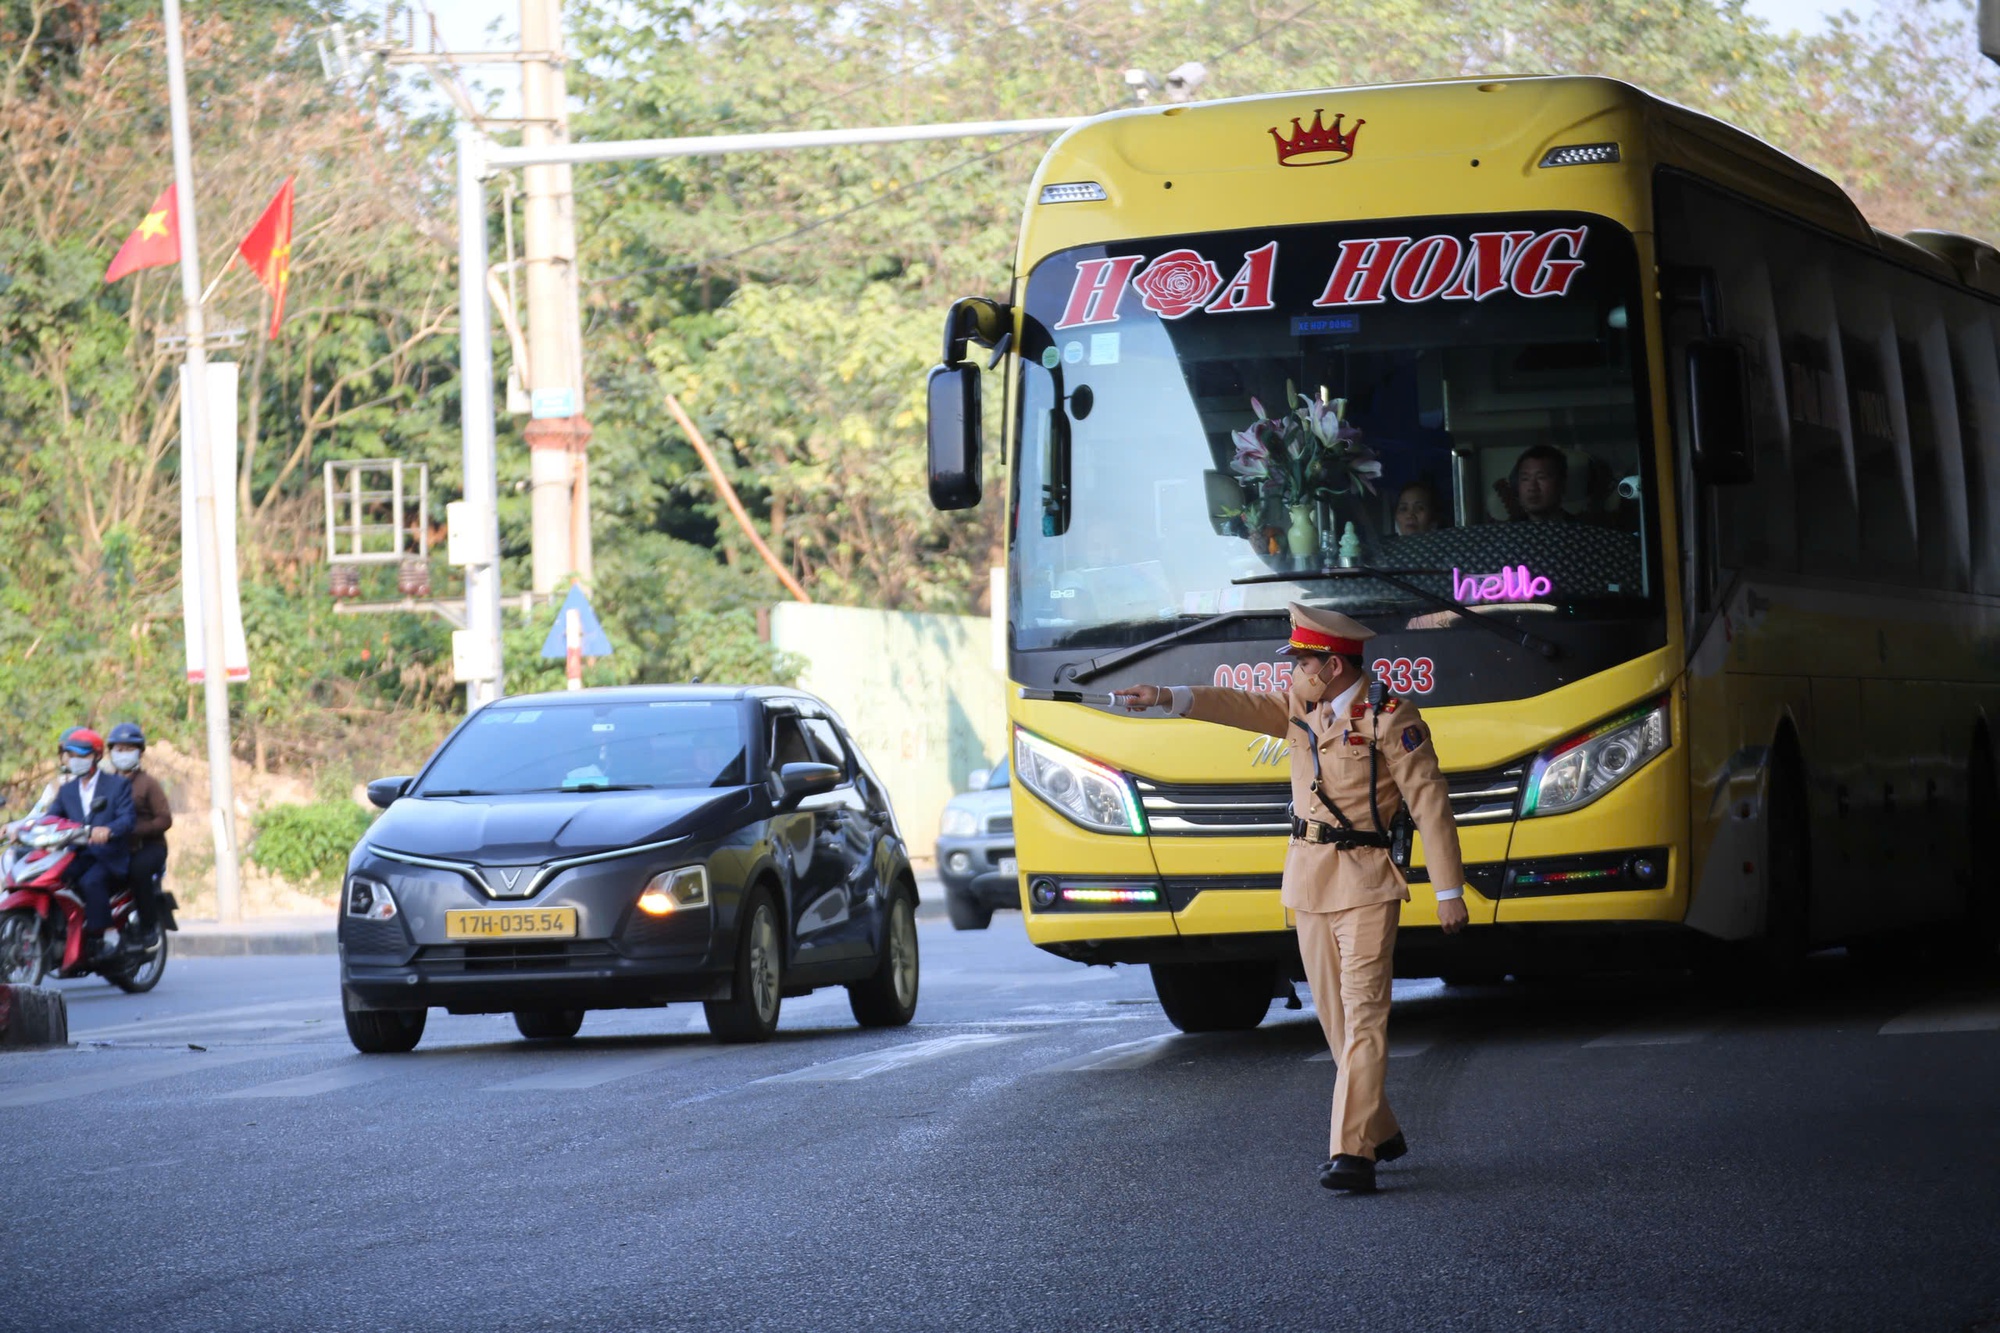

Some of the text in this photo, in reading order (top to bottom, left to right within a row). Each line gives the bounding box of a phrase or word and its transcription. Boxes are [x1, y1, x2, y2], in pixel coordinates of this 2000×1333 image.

[1313, 225, 1589, 308] HONG
[1452, 564, 1552, 601] hello
[1371, 656, 1434, 694] 333
[459, 913, 564, 934] 17H-035.54
